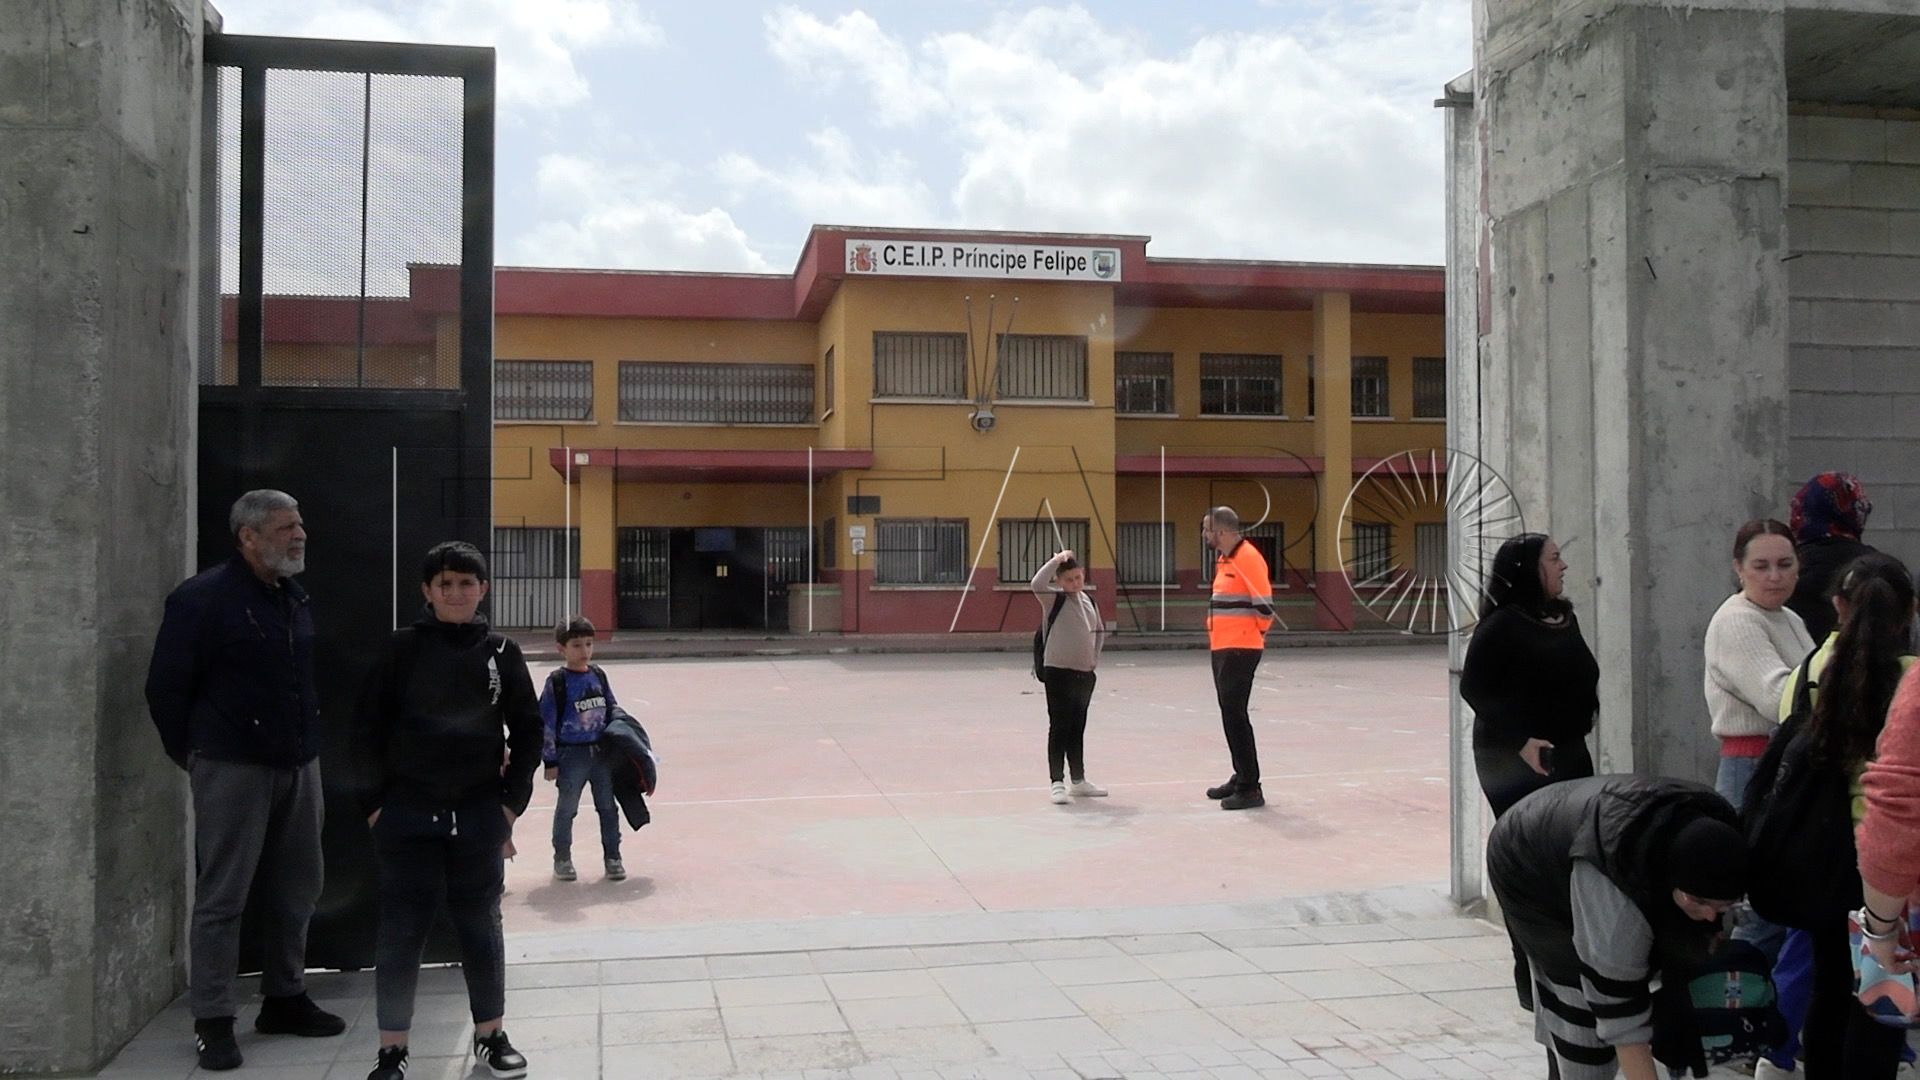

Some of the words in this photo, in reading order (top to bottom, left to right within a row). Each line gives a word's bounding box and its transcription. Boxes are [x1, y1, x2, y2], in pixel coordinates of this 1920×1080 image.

[882, 245, 946, 267] C.E.I.P.
[952, 248, 1027, 274] Príncipe
[1033, 250, 1087, 275] Felipe
